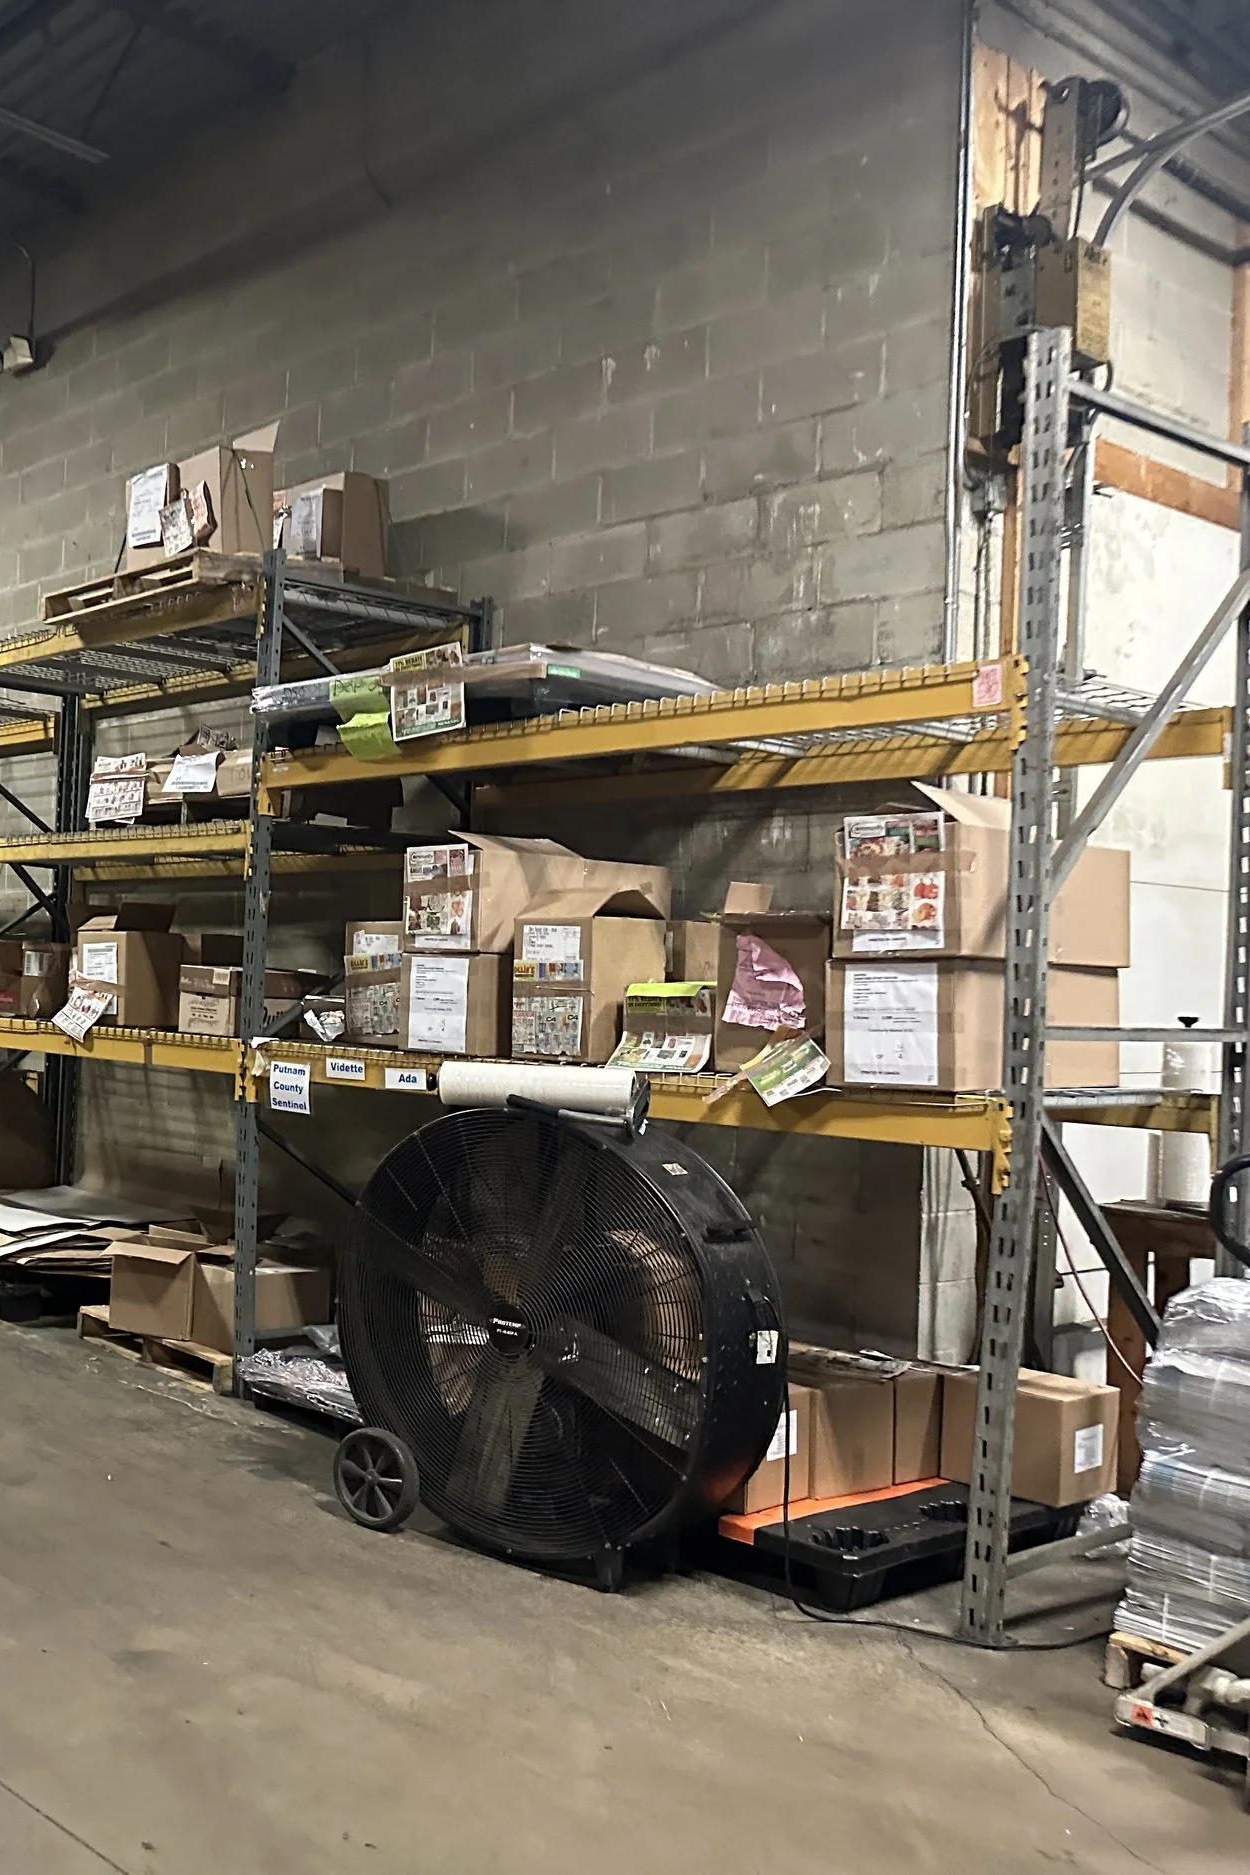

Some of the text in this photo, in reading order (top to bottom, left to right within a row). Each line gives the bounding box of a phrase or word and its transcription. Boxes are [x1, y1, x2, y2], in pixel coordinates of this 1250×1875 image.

[273, 1064, 306, 1076] Putnam
[330, 1062, 363, 1073] Vidette
[398, 1073, 417, 1083] Ada
[273, 1081, 304, 1095] County
[272, 1097, 307, 1110] Sentinel
